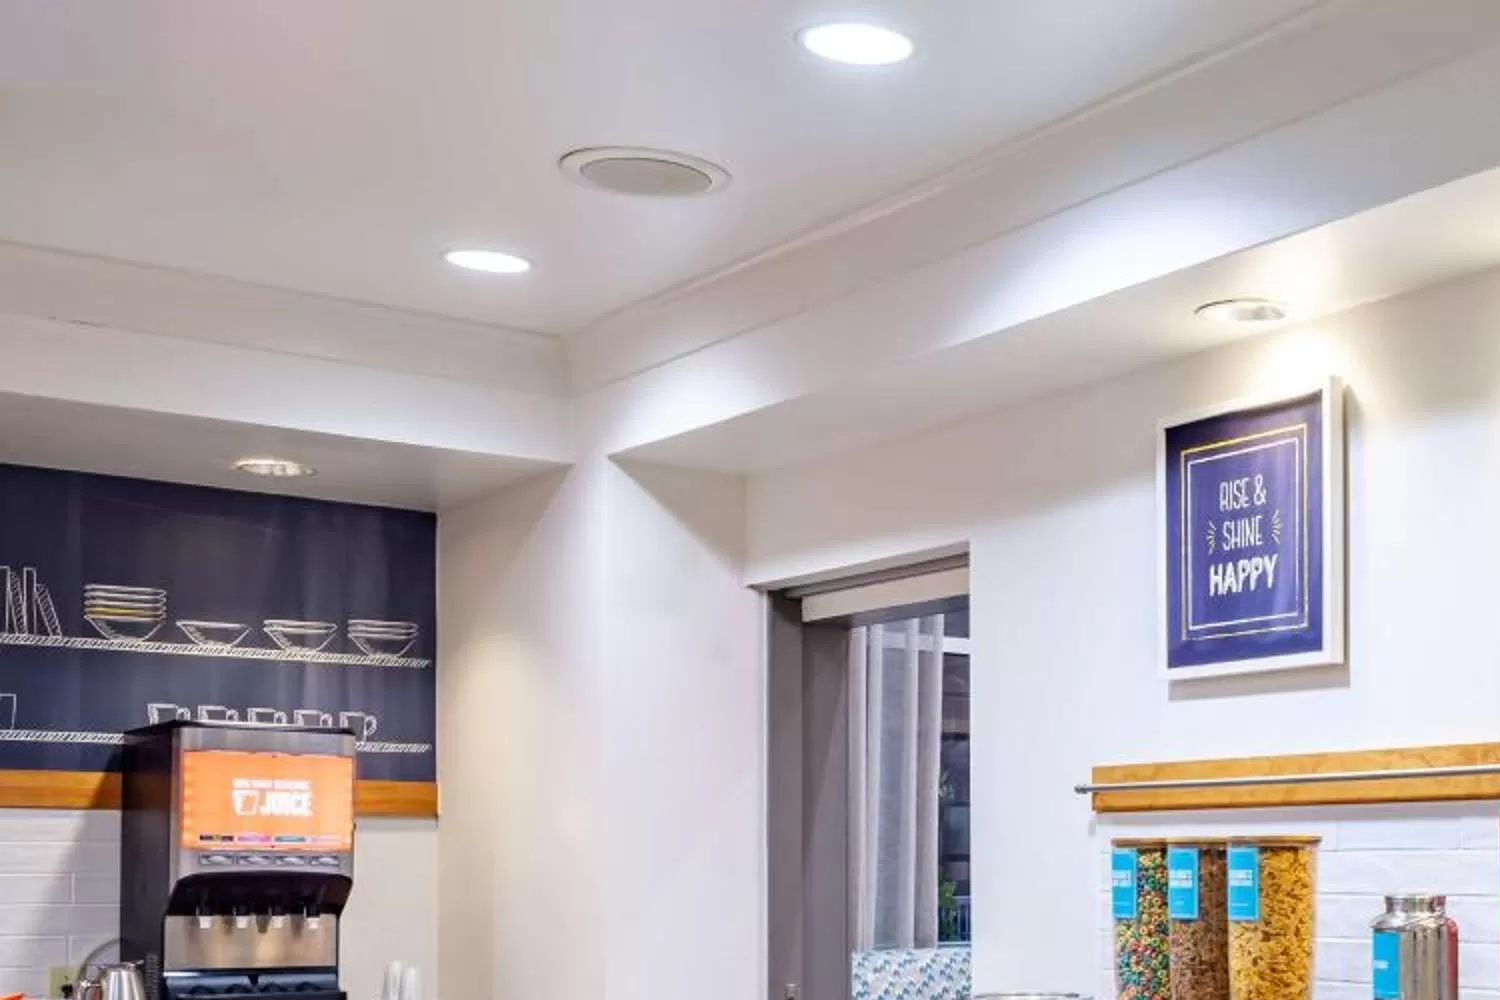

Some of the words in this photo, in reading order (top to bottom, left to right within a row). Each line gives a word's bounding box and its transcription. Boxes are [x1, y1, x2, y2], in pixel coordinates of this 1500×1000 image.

[1219, 477, 1250, 513] RISE
[1253, 473, 1266, 506] &
[1221, 515, 1264, 551] SHINE
[1209, 554, 1279, 597] HAPPY
